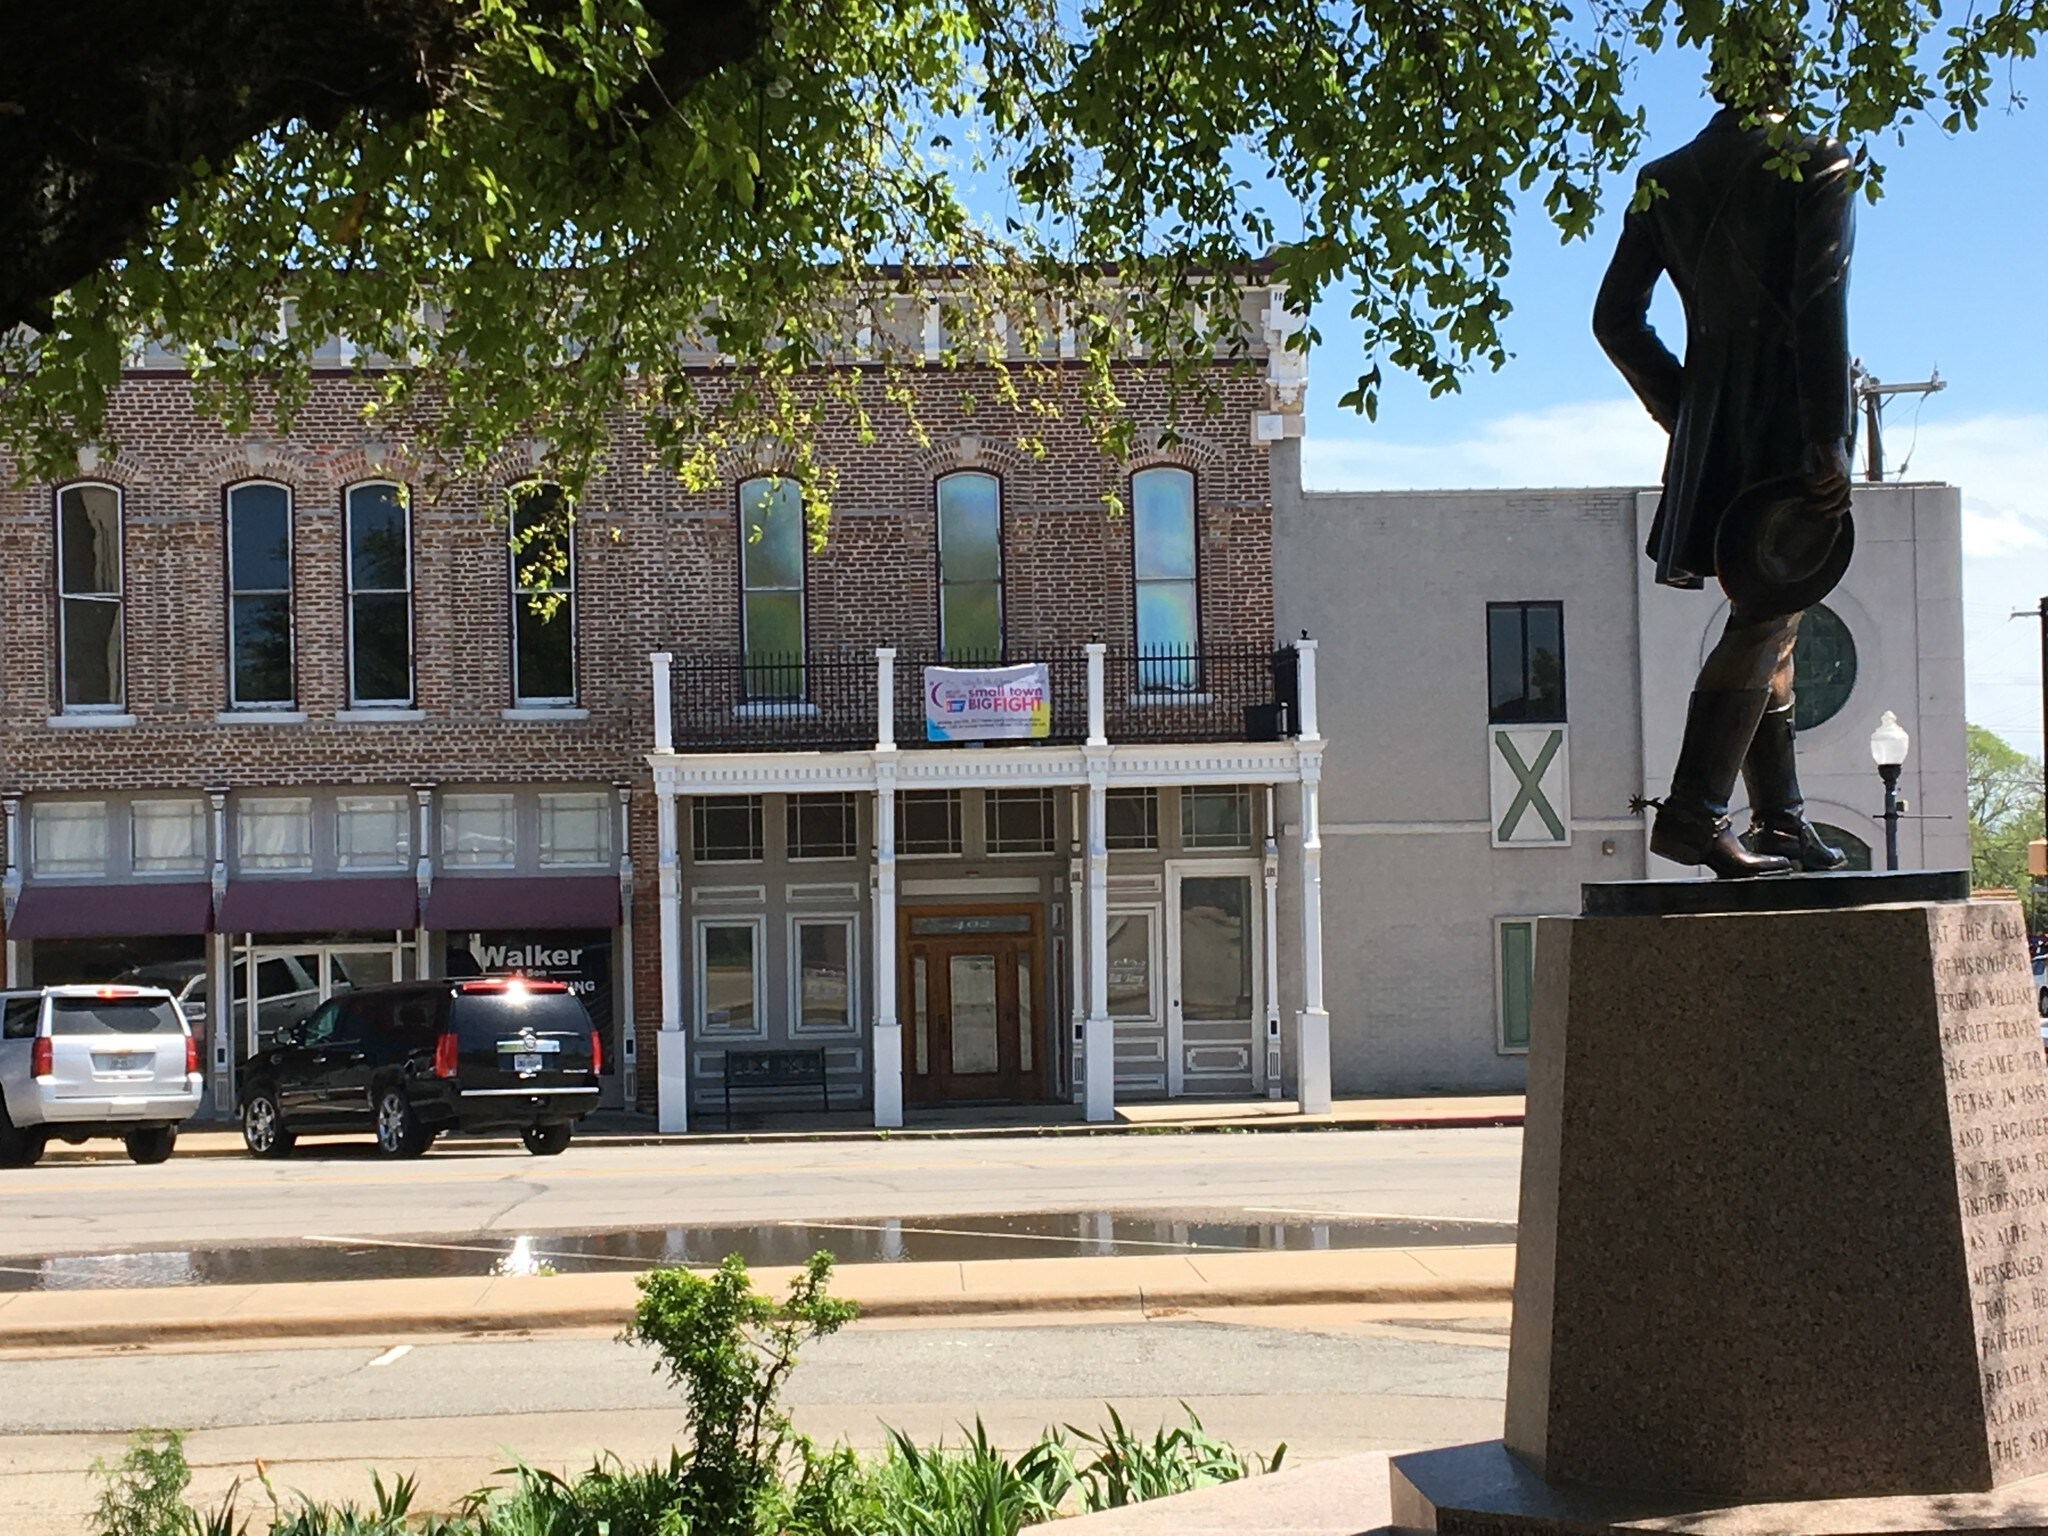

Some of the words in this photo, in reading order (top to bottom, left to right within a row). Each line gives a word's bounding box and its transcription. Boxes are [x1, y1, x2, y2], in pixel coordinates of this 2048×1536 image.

[968, 685, 1005, 697] small
[1009, 685, 1043, 697] town
[1935, 925, 1949, 943] AT
[1958, 922, 1984, 942] THE
[1991, 920, 2025, 940] CALL
[480, 944, 583, 968] Walker
[1953, 956, 1974, 976] HIS
[527, 968, 547, 977] Son
[1940, 989, 1980, 1013] FRIEND
[1953, 1091, 1994, 1114] TEXAS
[2002, 1087, 2016, 1108] IN
[1958, 1127, 1984, 1148] AND
[1980, 1160, 2004, 1180] THE
[1963, 1186, 2048, 1218] INDEPENDEN
[1982, 1325, 2044, 1360] FAITHFUL
[1985, 1363, 2031, 1394] DEATH
[1994, 1436, 2021, 1460] THE
